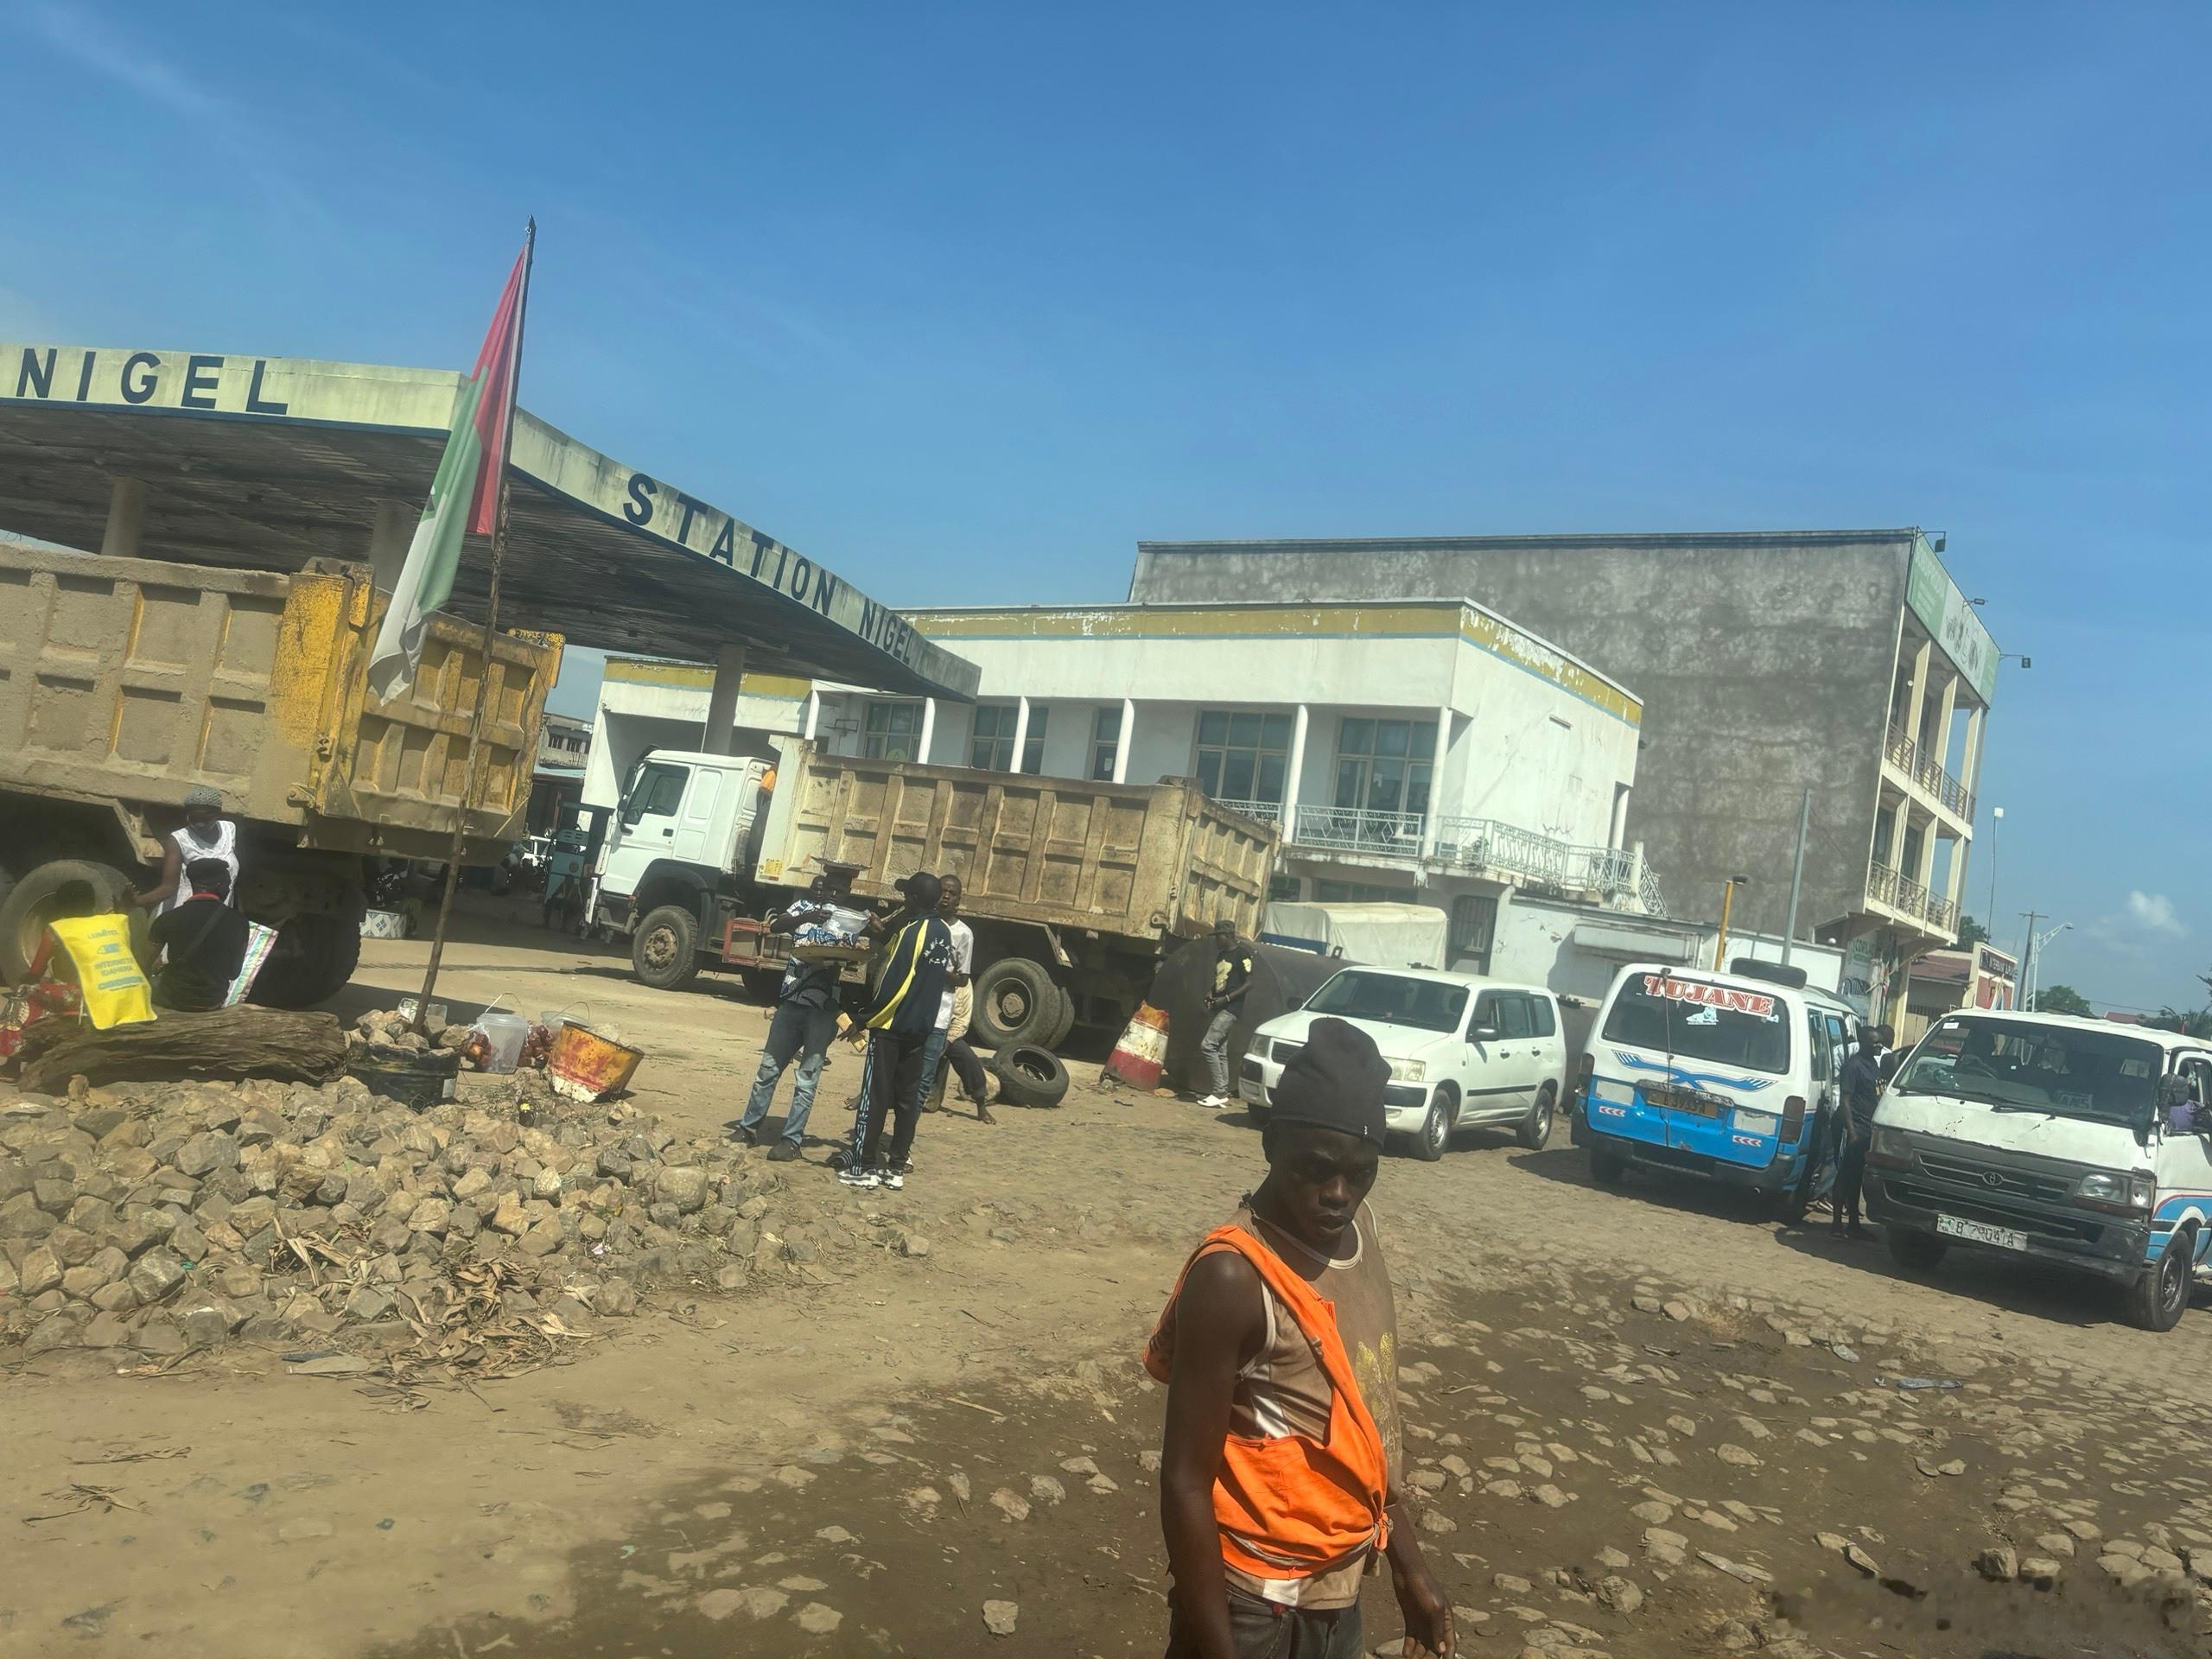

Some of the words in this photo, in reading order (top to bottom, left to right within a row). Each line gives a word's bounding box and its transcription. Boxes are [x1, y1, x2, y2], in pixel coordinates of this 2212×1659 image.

[16, 348, 289, 415] NIGEL
[623, 474, 836, 615] STATION
[859, 599, 912, 665] NIGEL
[1644, 976, 1773, 1015] TUJANE
